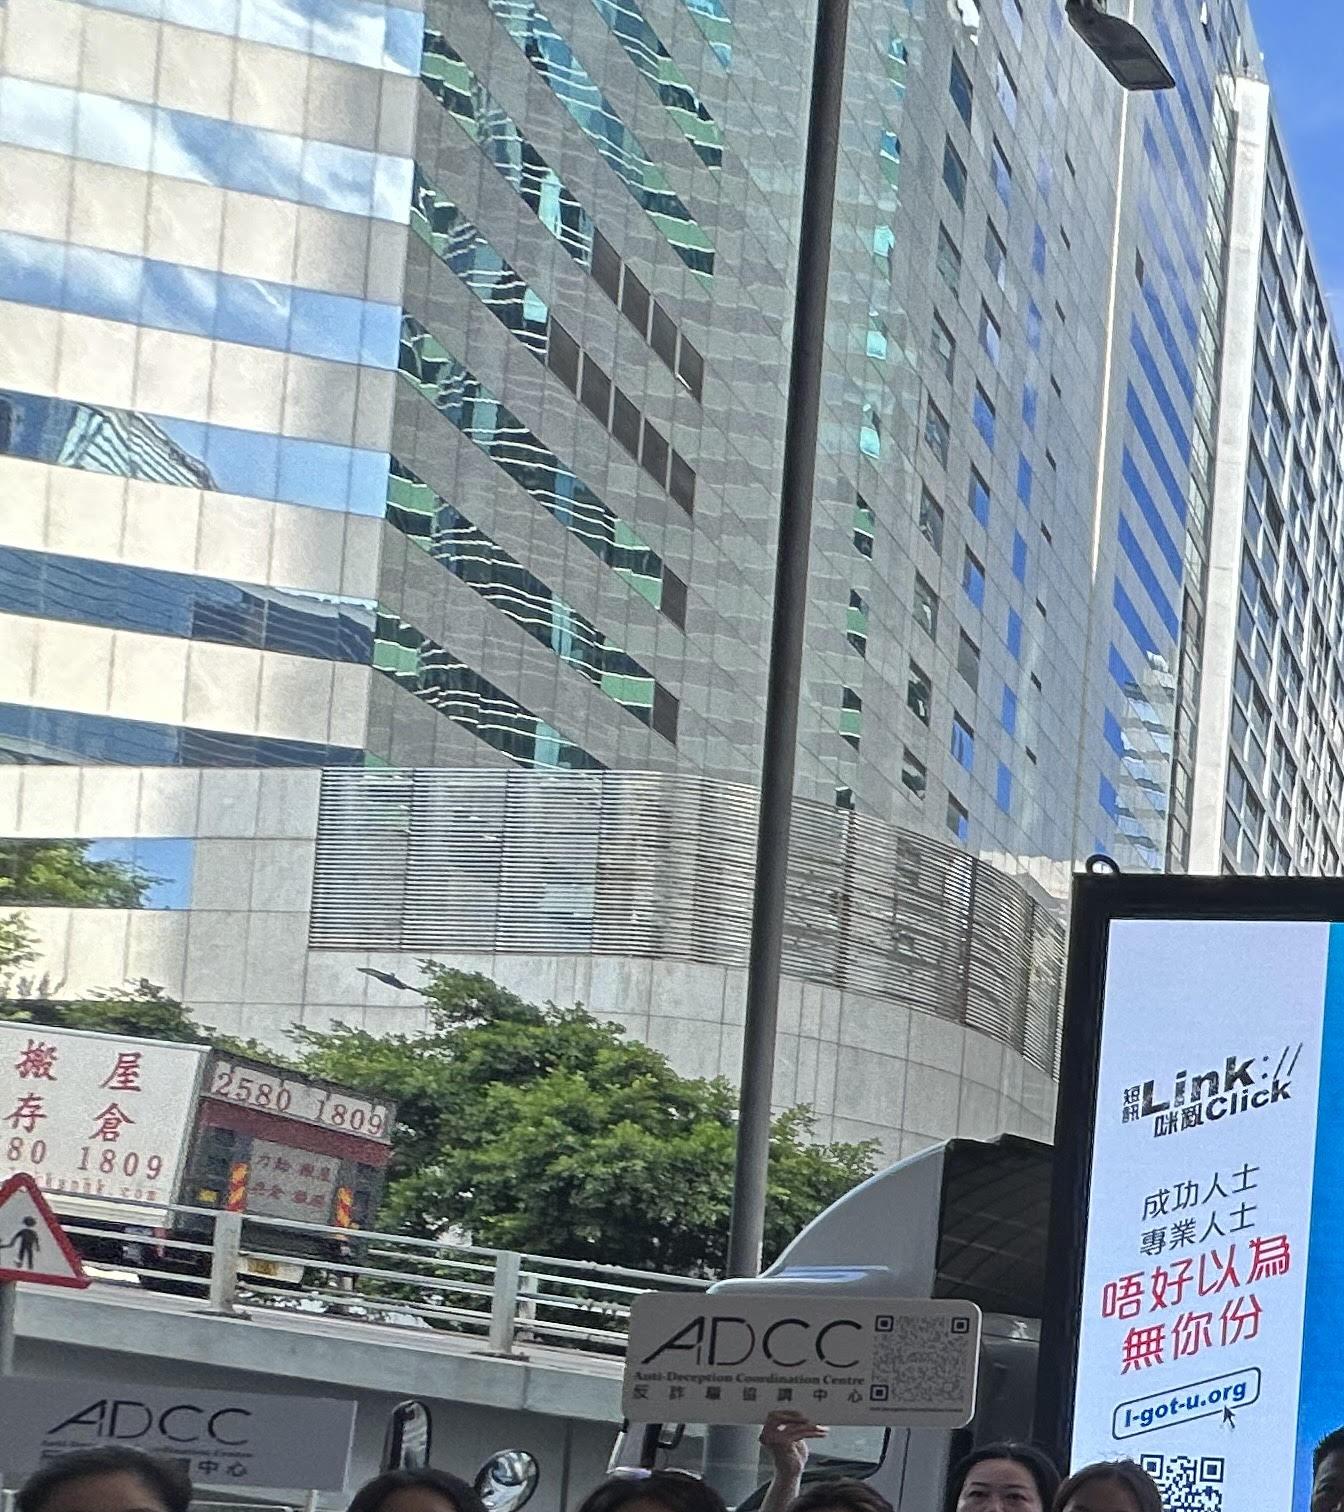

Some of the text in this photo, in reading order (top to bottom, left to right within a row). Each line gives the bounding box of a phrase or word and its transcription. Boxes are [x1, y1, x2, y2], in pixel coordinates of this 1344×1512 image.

[216, 1072, 386, 1136] 2580 1809
[78, 1145, 163, 1180] 1809
[1141, 1163, 1260, 1222] 成功人士
[1138, 1202, 1258, 1257] 專業人士
[1101, 1233, 1291, 1321] 唔好以為
[641, 1315, 863, 1369] ADCC
[1120, 1294, 1263, 1375] 無你份
[47, 1399, 252, 1446] ADCC
